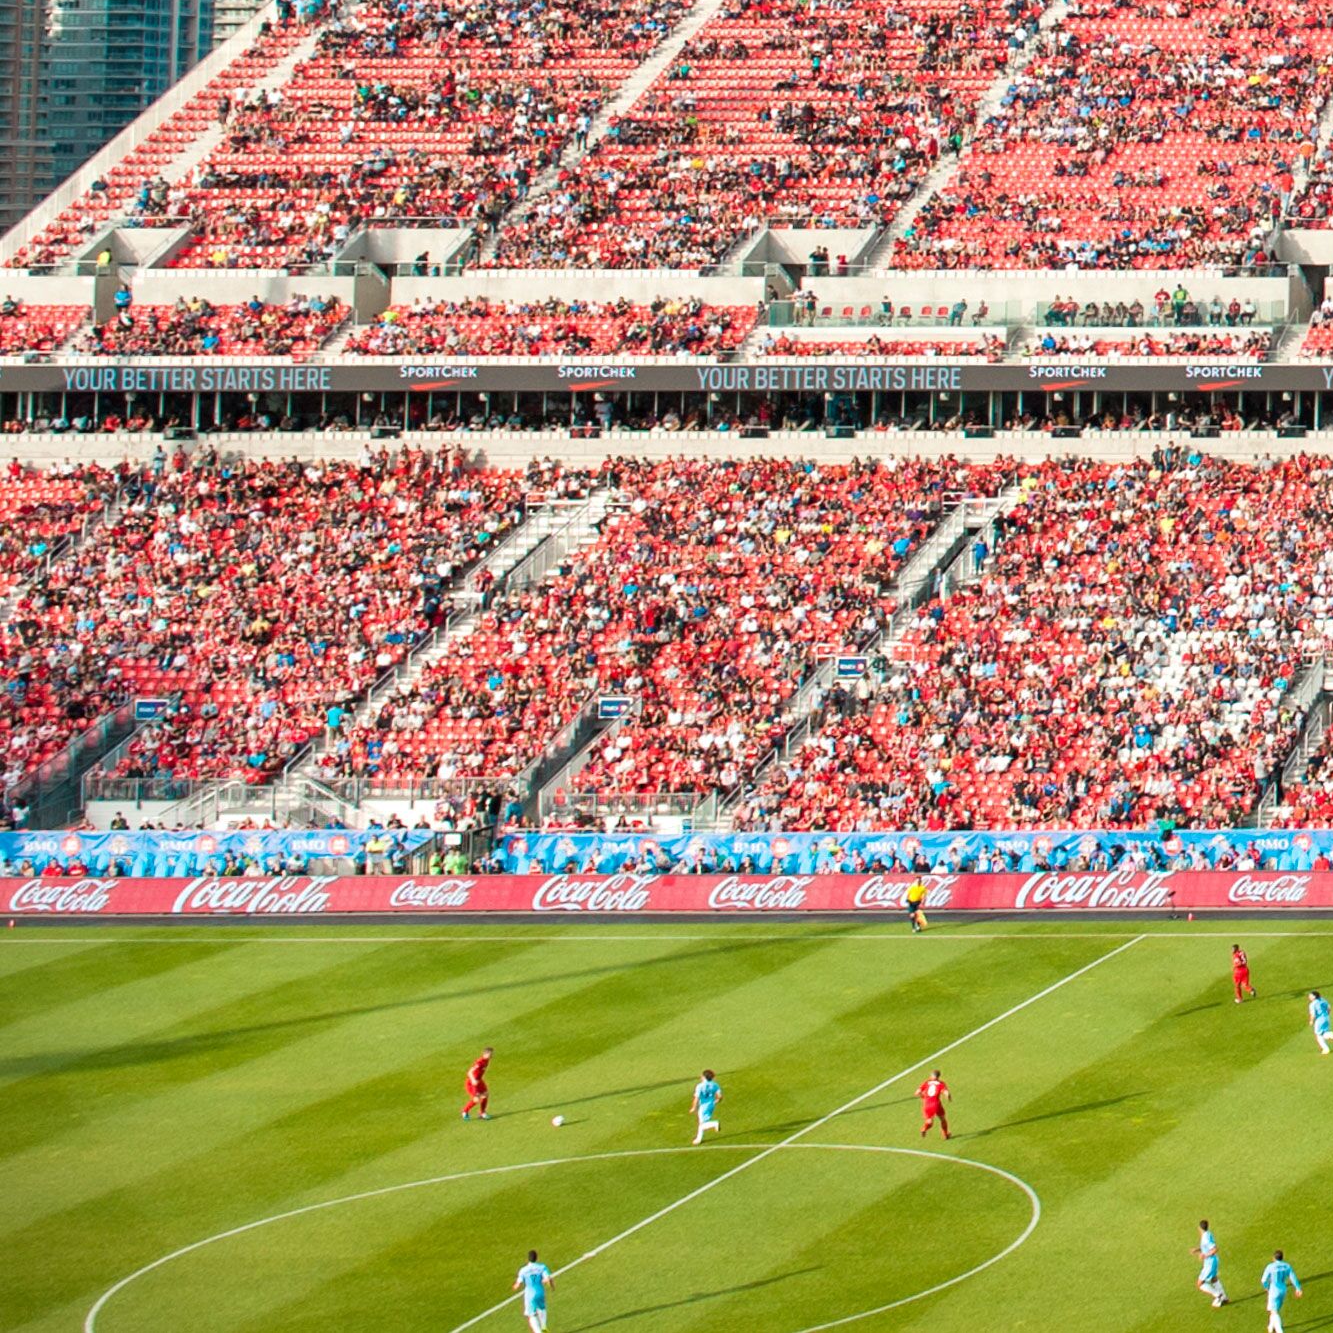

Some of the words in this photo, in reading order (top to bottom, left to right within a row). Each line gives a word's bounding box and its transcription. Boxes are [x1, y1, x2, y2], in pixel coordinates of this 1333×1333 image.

[62, 368, 116, 389] YOUR
[122, 368, 195, 389] BETTER
[201, 368, 274, 389] STARTS
[281, 368, 331, 389] HERE
[697, 368, 749, 389] YOUR
[755, 368, 827, 389] BETTER
[833, 368, 905, 389] STARTS
[912, 368, 961, 389] HERE
[24, 842, 57, 852] BMO
[160, 841, 192, 852] BMO
[293, 840, 325, 851] BMO
[734, 842, 766, 853] BMO
[997, 841, 1029, 851] BMO
[1256, 839, 1289, 849] BMO
[10, 879, 119, 911] Coca-Cola
[173, 876, 338, 912] Coca-Cola
[390, 880, 477, 906] Coca-Cola
[533, 874, 660, 910] Coca-Cola
[709, 876, 815, 908] Coca-Cola
[1015, 872, 1175, 907] Coca-Cola
[1229, 875, 1311, 901] Coca-Cola
